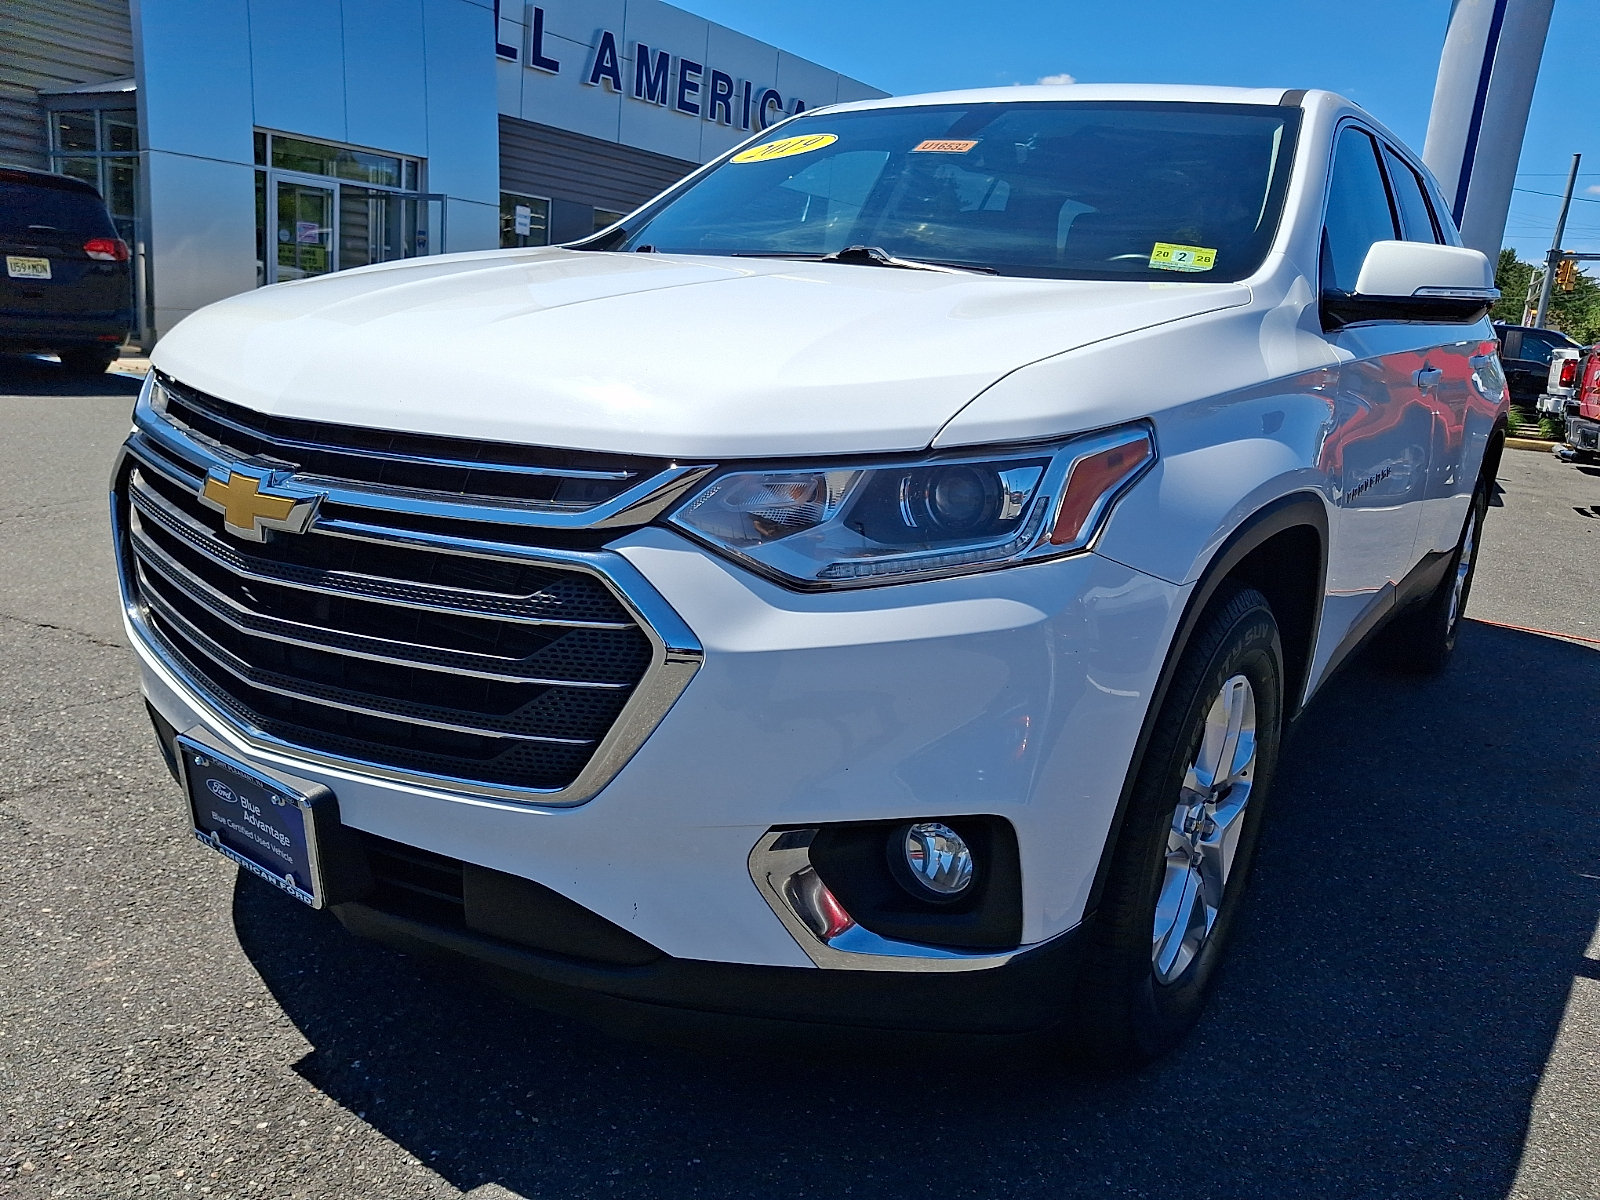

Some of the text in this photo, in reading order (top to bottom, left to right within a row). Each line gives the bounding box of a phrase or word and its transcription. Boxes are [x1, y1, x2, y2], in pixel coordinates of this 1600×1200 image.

[921, 141, 969, 151] U16532
[1155, 250, 1211, 263] 20 2 28
[212, 781, 233, 801] Ford
[240, 795, 261, 817] Blue
[211, 811, 294, 864] Blue Certified Used Vehicle
[243, 811, 291, 847] Advantage
[219, 847, 277, 886] AMERICAN
[280, 880, 313, 905] FORD
